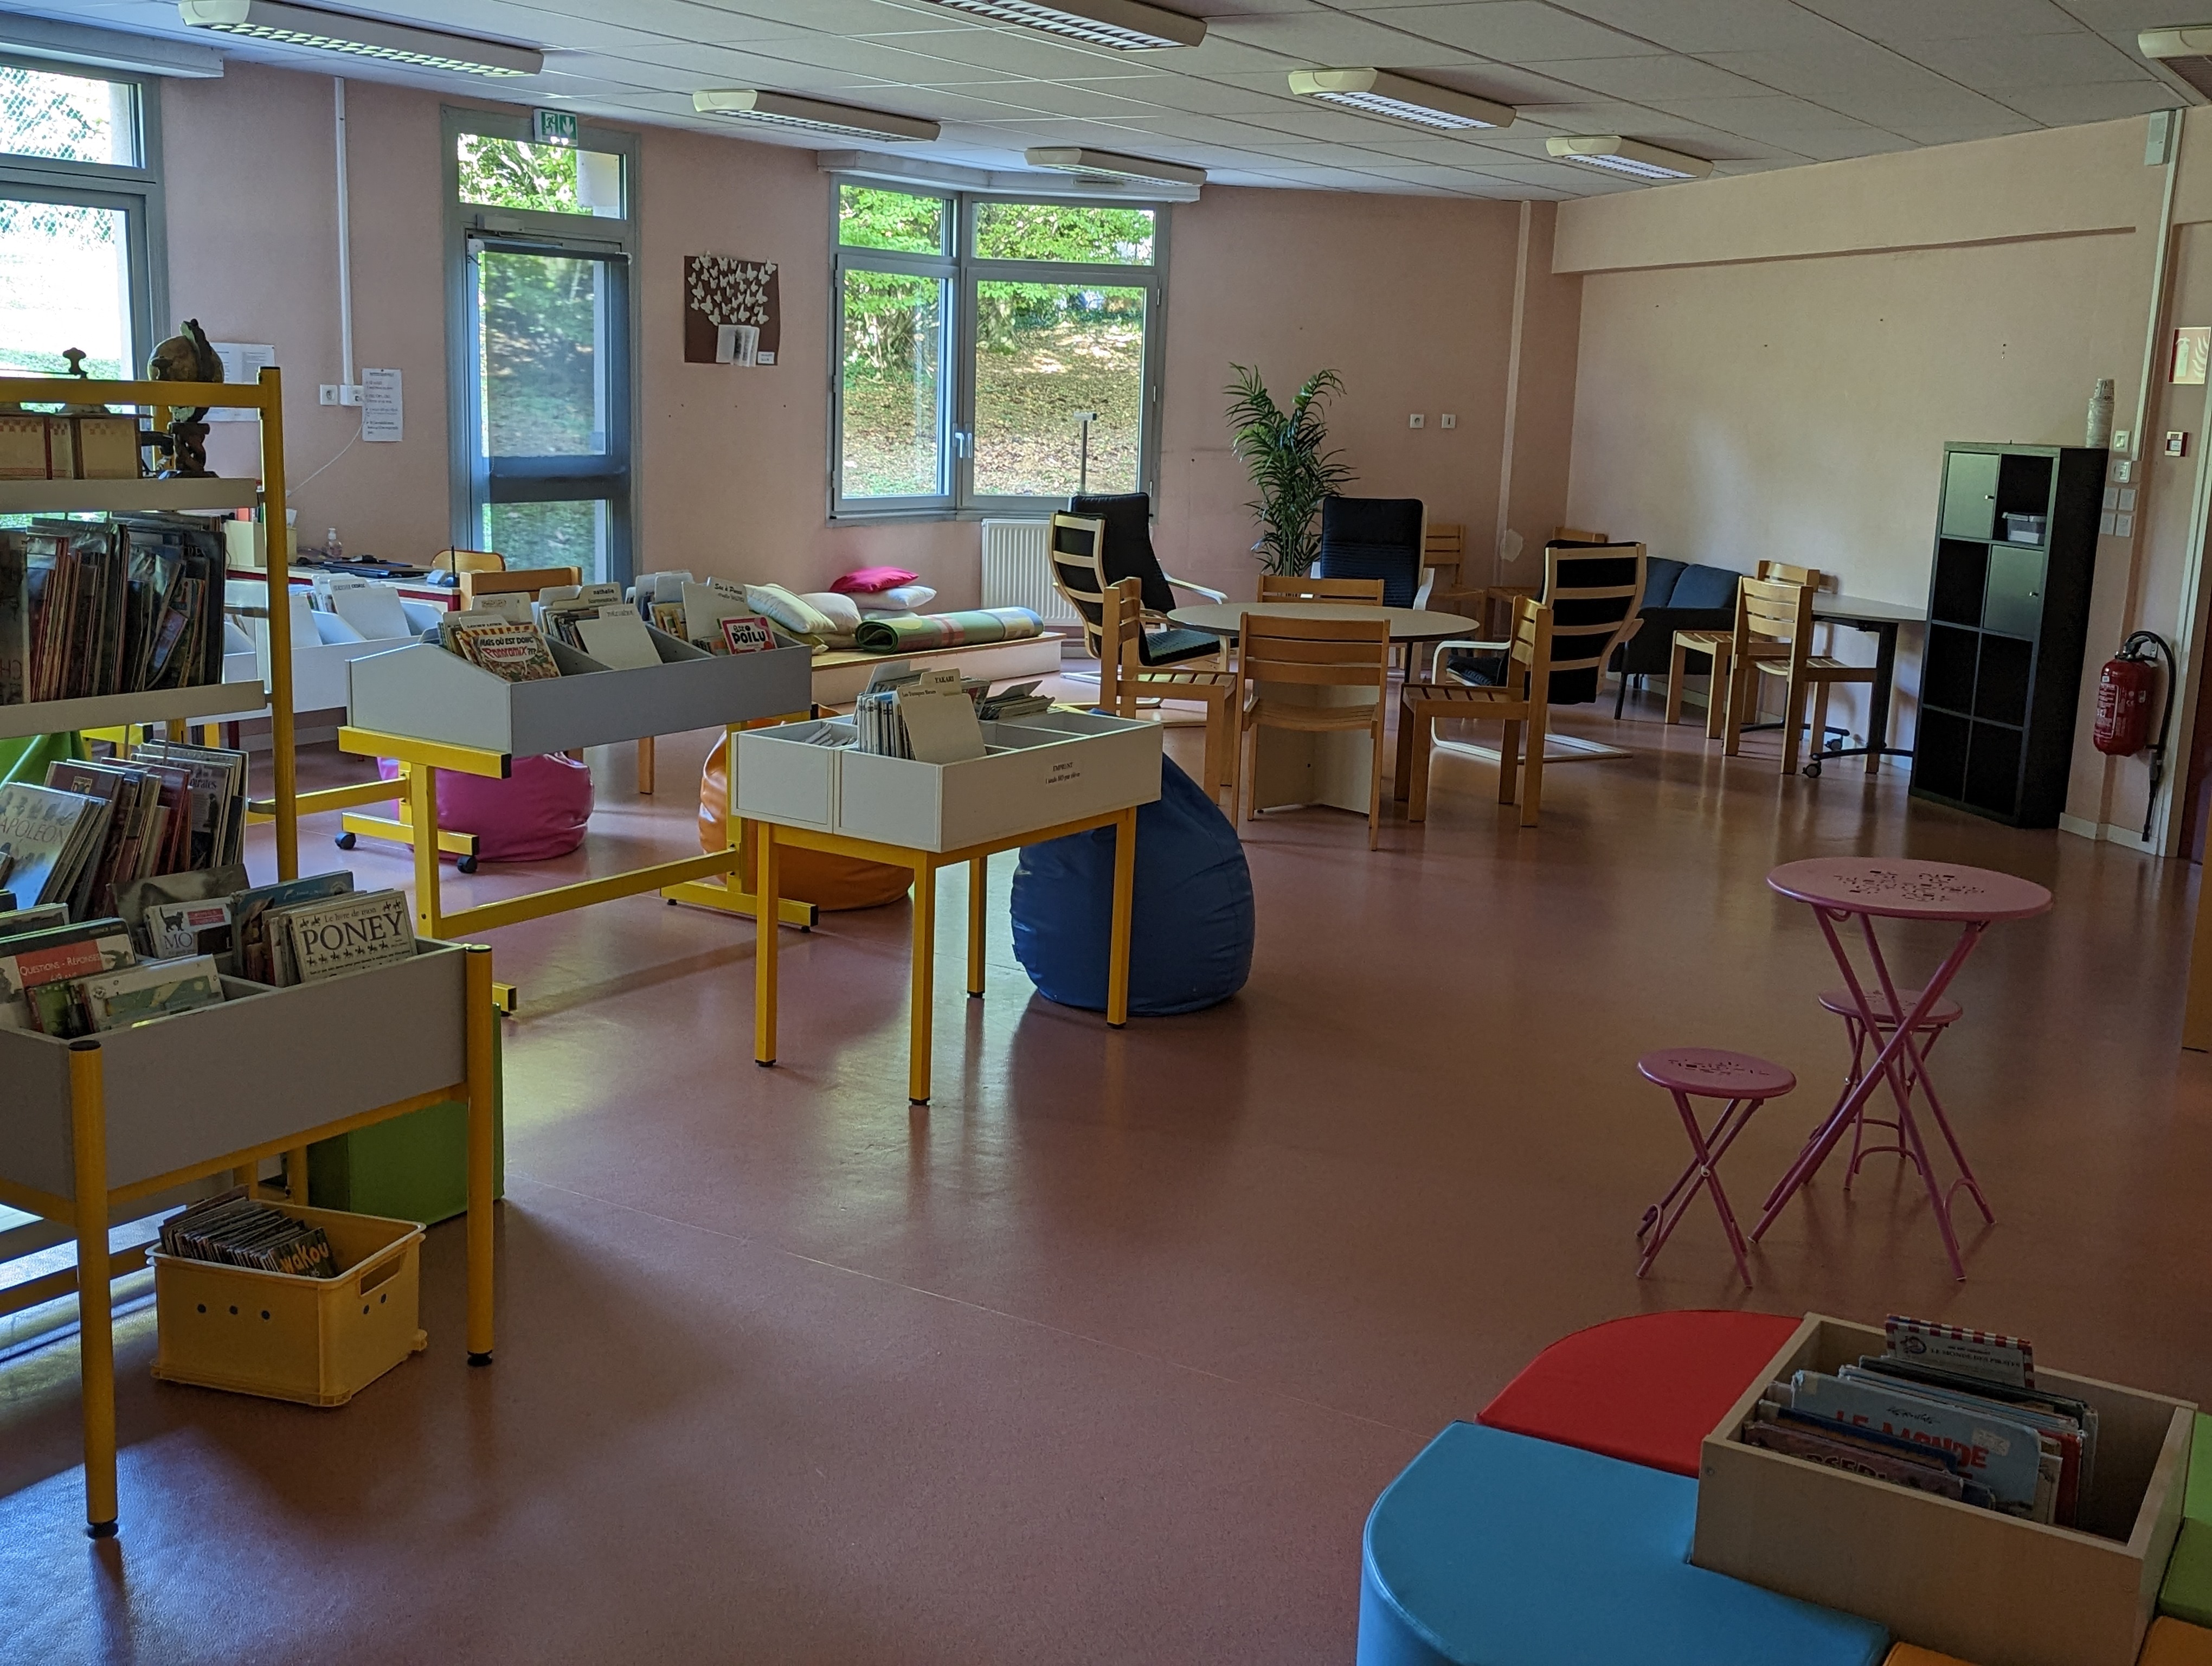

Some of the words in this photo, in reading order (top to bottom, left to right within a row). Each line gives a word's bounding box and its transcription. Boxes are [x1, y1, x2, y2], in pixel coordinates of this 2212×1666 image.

[505, 637, 516, 645] EST
[516, 636, 533, 644] DONC
[731, 631, 766, 644] POILU
[935, 675, 954, 684] YAKARI
[324, 915, 333, 923] Le
[351, 909, 360, 917] de
[361, 907, 376, 915] mon
[300, 911, 403, 956] PONEY
[20, 962, 60, 976] QUESTIONS
